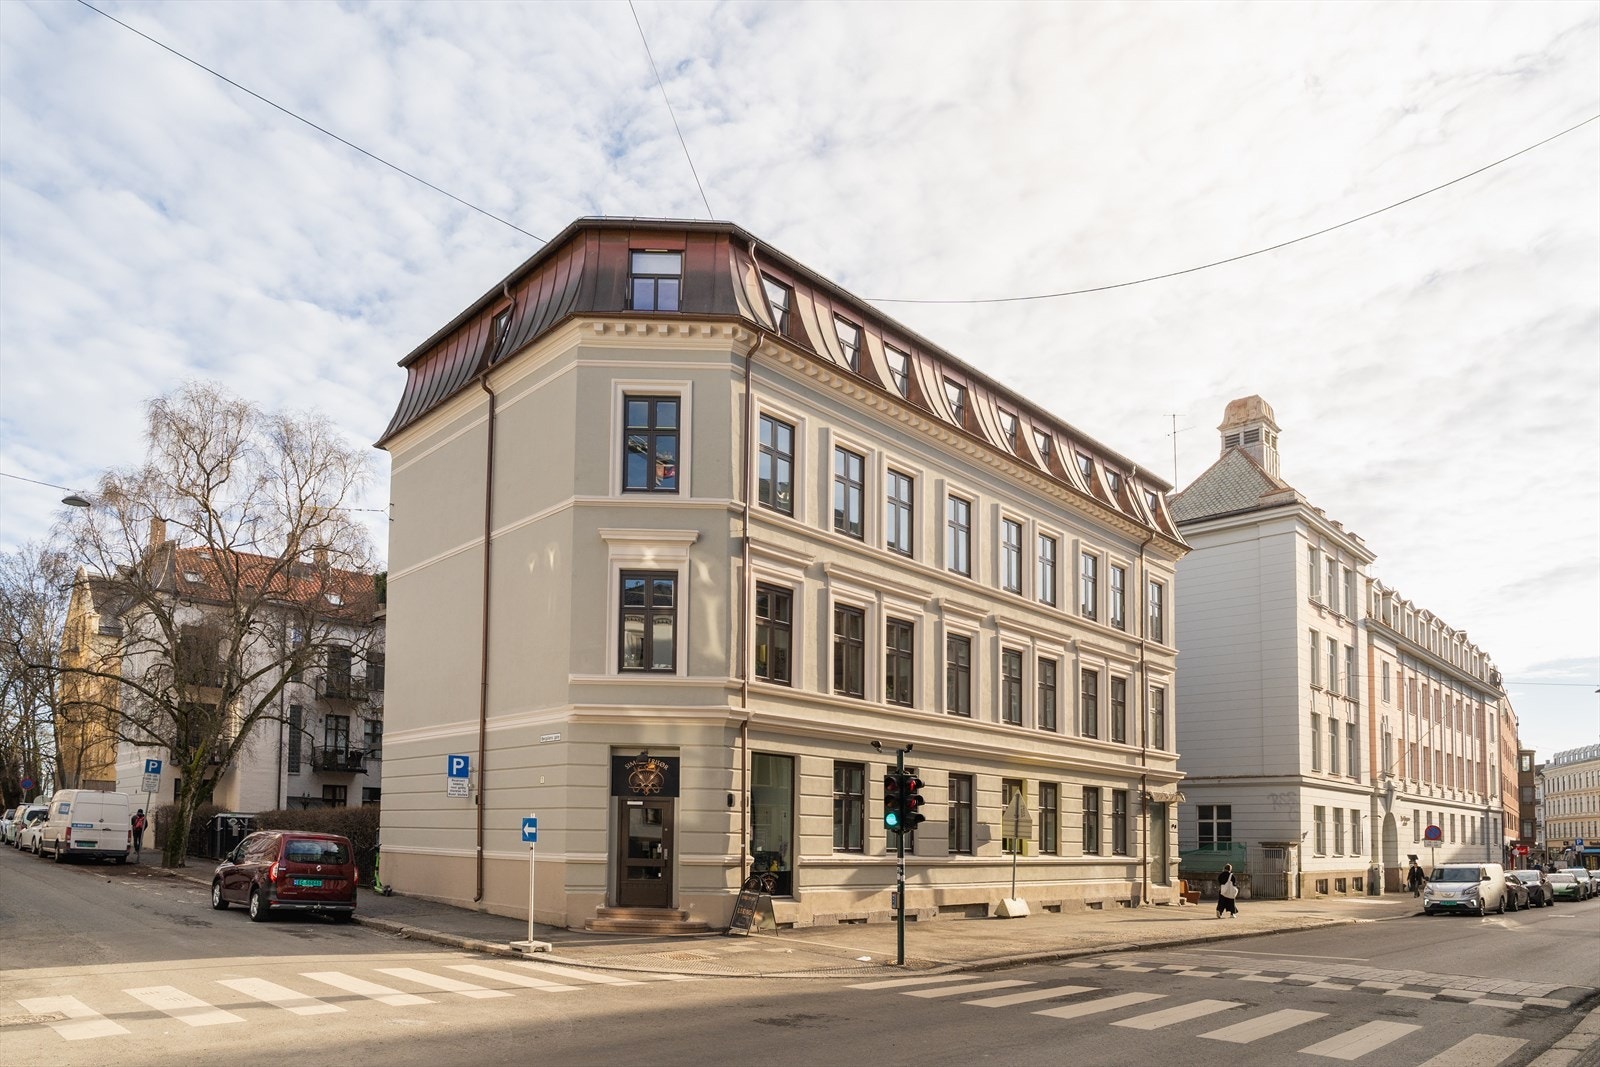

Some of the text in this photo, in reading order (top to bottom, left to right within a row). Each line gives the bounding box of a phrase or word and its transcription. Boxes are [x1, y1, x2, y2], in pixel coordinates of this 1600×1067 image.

[148, 761, 158, 772] P
[453, 757, 465, 775] P
[648, 757, 669, 771] FRISØR
